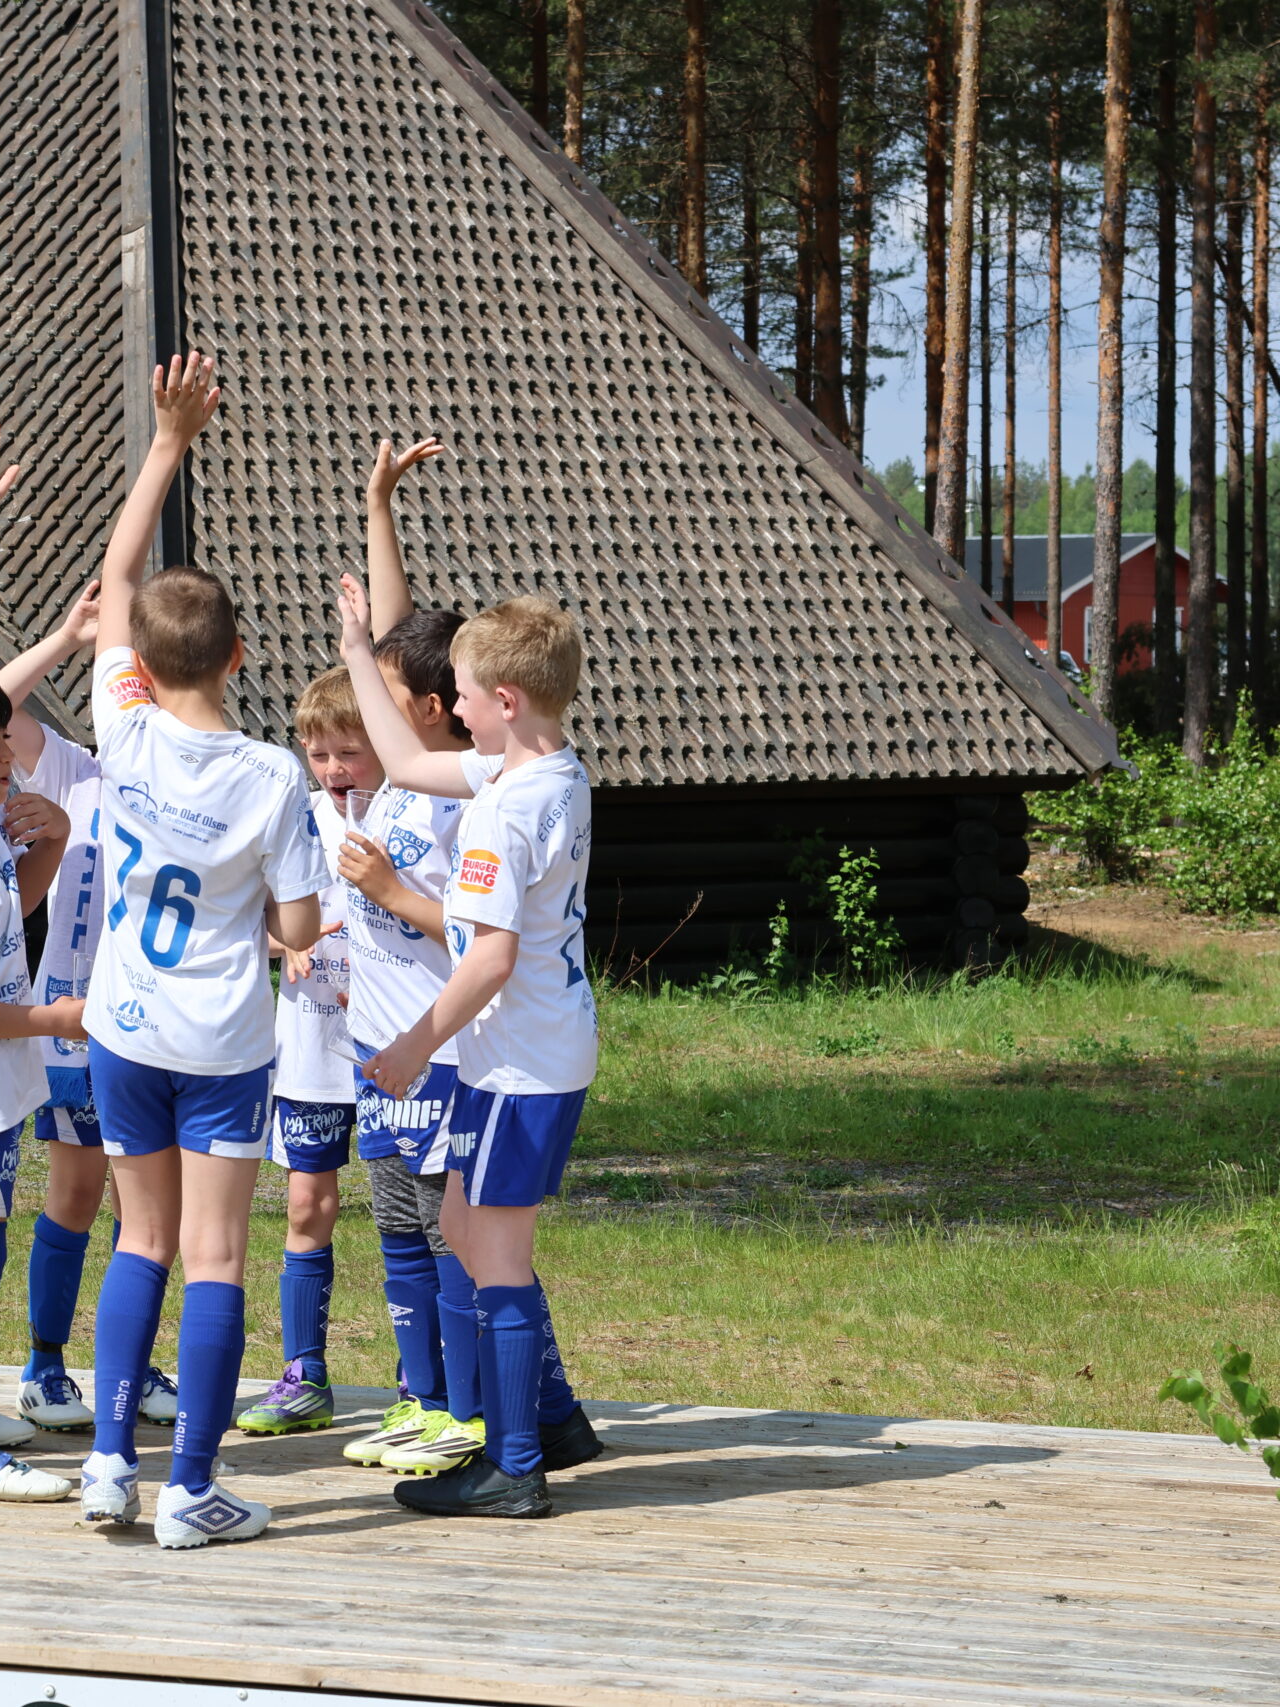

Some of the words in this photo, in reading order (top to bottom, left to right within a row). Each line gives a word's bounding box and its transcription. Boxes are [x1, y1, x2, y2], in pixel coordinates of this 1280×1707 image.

[160, 801, 178, 816] Jan
[180, 808, 202, 824] Olaf
[202, 815, 228, 832] Olsen
[392, 827, 429, 850] EIDSKOG
[460, 868, 497, 888] KING
[462, 858, 499, 875] BURGER
[347, 889, 395, 922] areBank
[349, 936, 416, 969] eprodukter
[115, 1011, 150, 1029] HAGERUD
[251, 1101, 262, 1133] umbro
[284, 1108, 345, 1134] MATRAND
[302, 1125, 347, 1145] CUP
[113, 1379, 131, 1421] umbro
[174, 1410, 188, 1454] umbro
